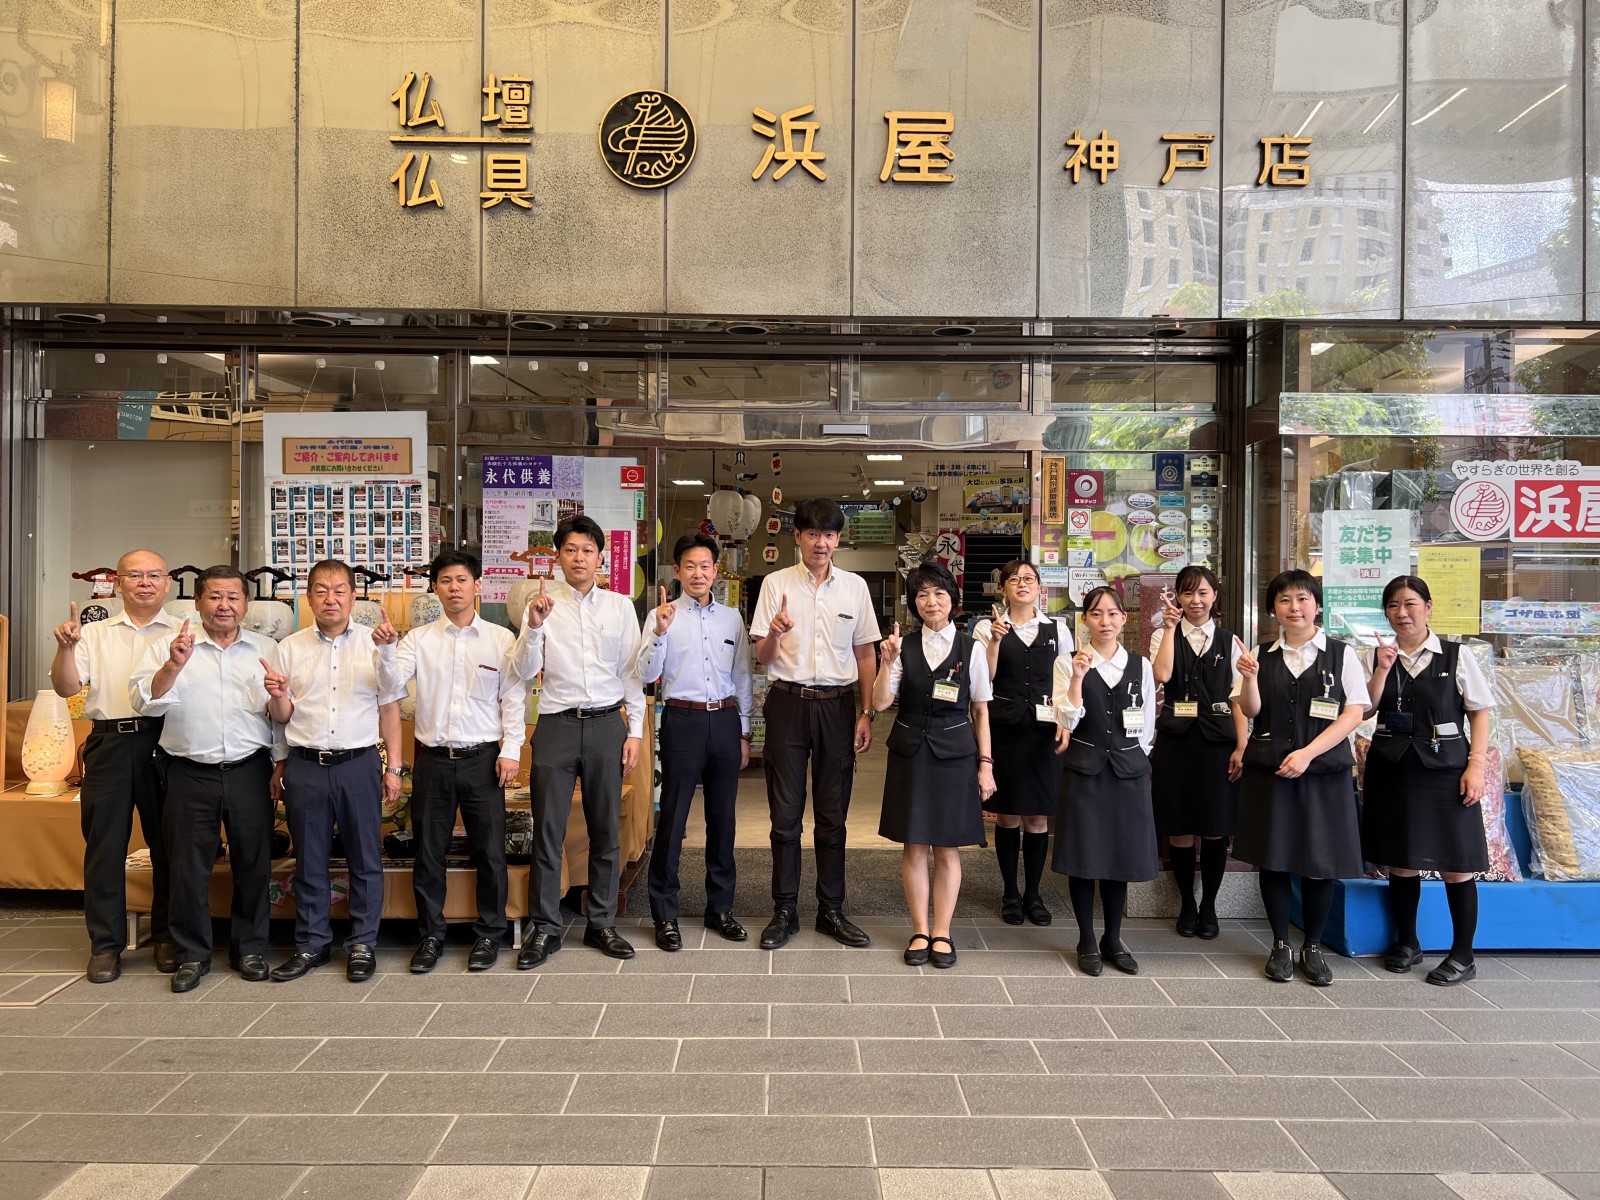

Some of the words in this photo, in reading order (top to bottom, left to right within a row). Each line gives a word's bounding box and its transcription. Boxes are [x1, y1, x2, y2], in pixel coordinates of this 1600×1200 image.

[391, 72, 533, 129] 仏壇
[752, 104, 956, 184] 浜屋
[1064, 128, 1314, 186] 神戸店
[390, 151, 534, 209] 仏具
[294, 452, 400, 462] ご紹介・ご案内しております
[484, 468, 552, 485] 永代供養
[1456, 464, 1580, 476] やすらぎの世界を創る
[1339, 525, 1393, 543] 友だち
[1339, 547, 1393, 564] 募集中
[1360, 568, 1380, 578] 浜屋
[1504, 609, 1581, 619] ゴザ座布団
